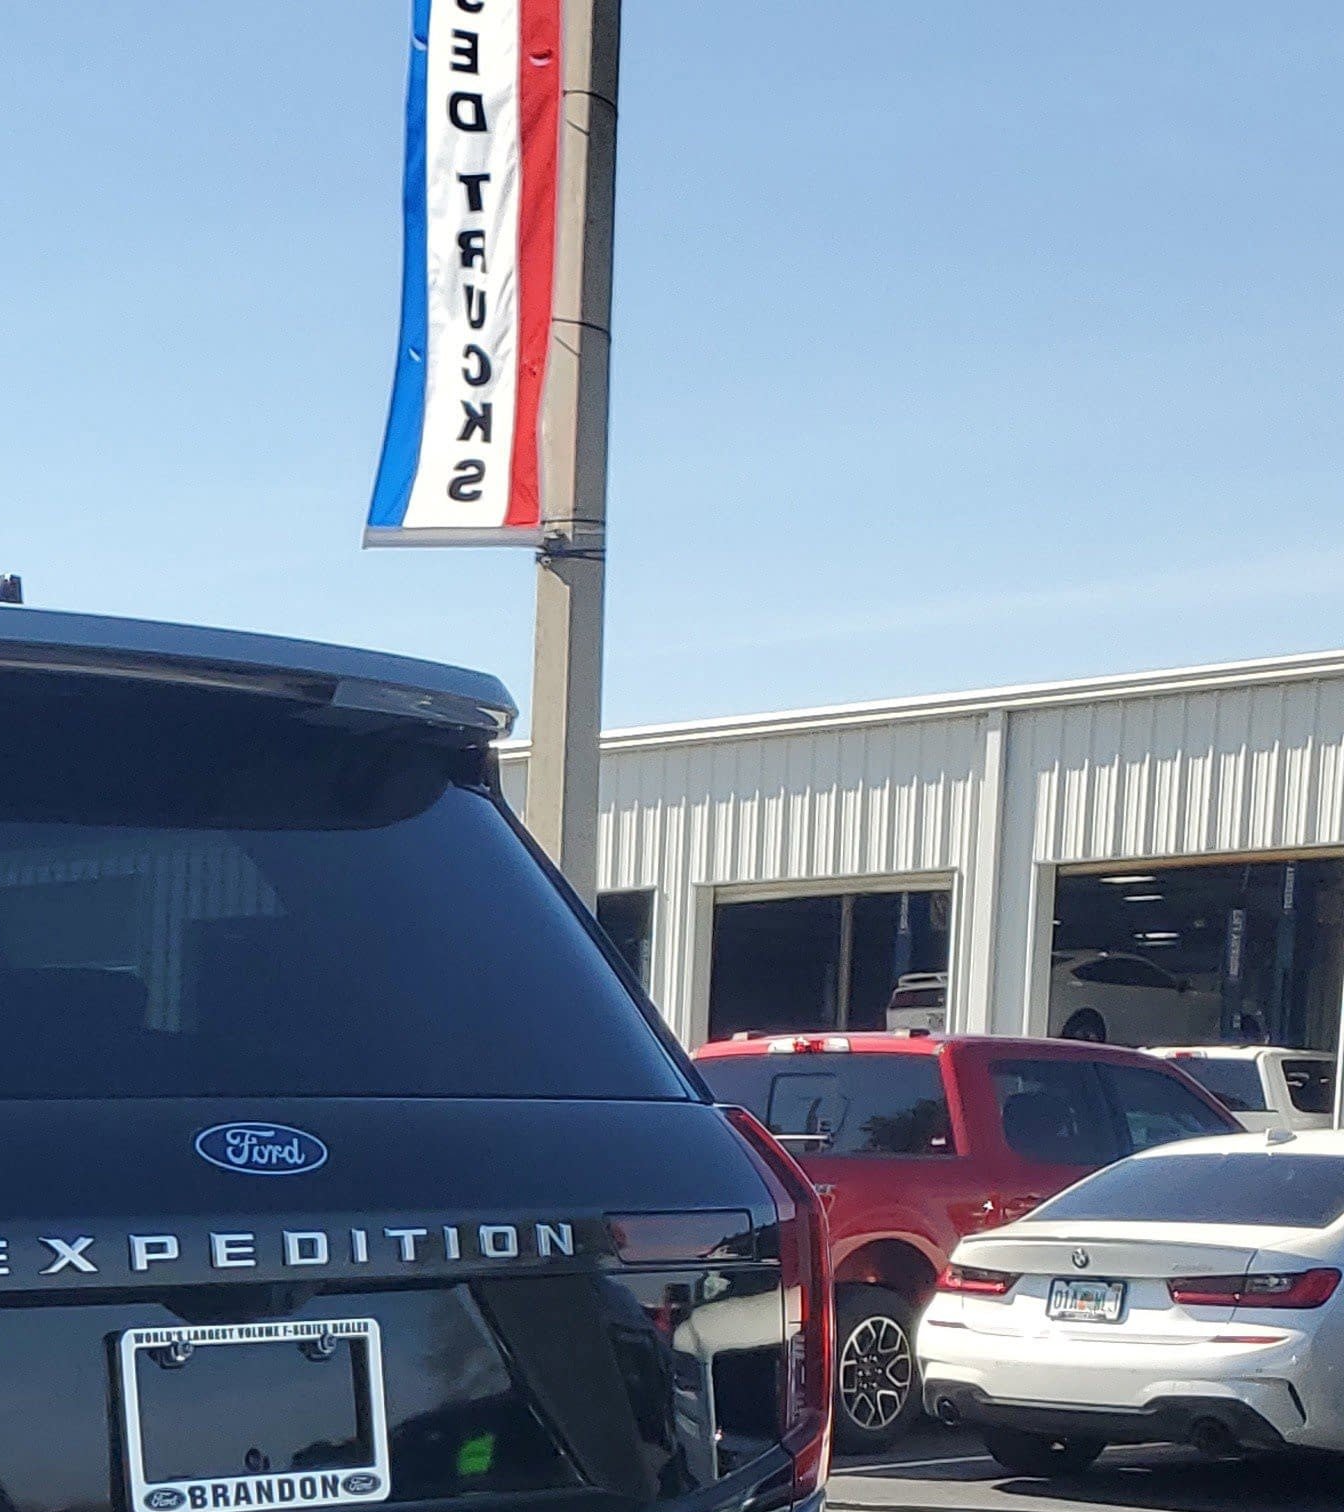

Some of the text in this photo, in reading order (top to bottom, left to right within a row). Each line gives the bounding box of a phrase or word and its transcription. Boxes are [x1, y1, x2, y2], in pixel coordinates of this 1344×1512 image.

[225, 1128, 306, 1165] Ford
[187, 1328, 234, 1341] LARGEST
[238, 1326, 280, 1339] VOLUME
[332, 1321, 369, 1334] DEALER
[151, 1474, 374, 1510] Ford BRANDON Ford
